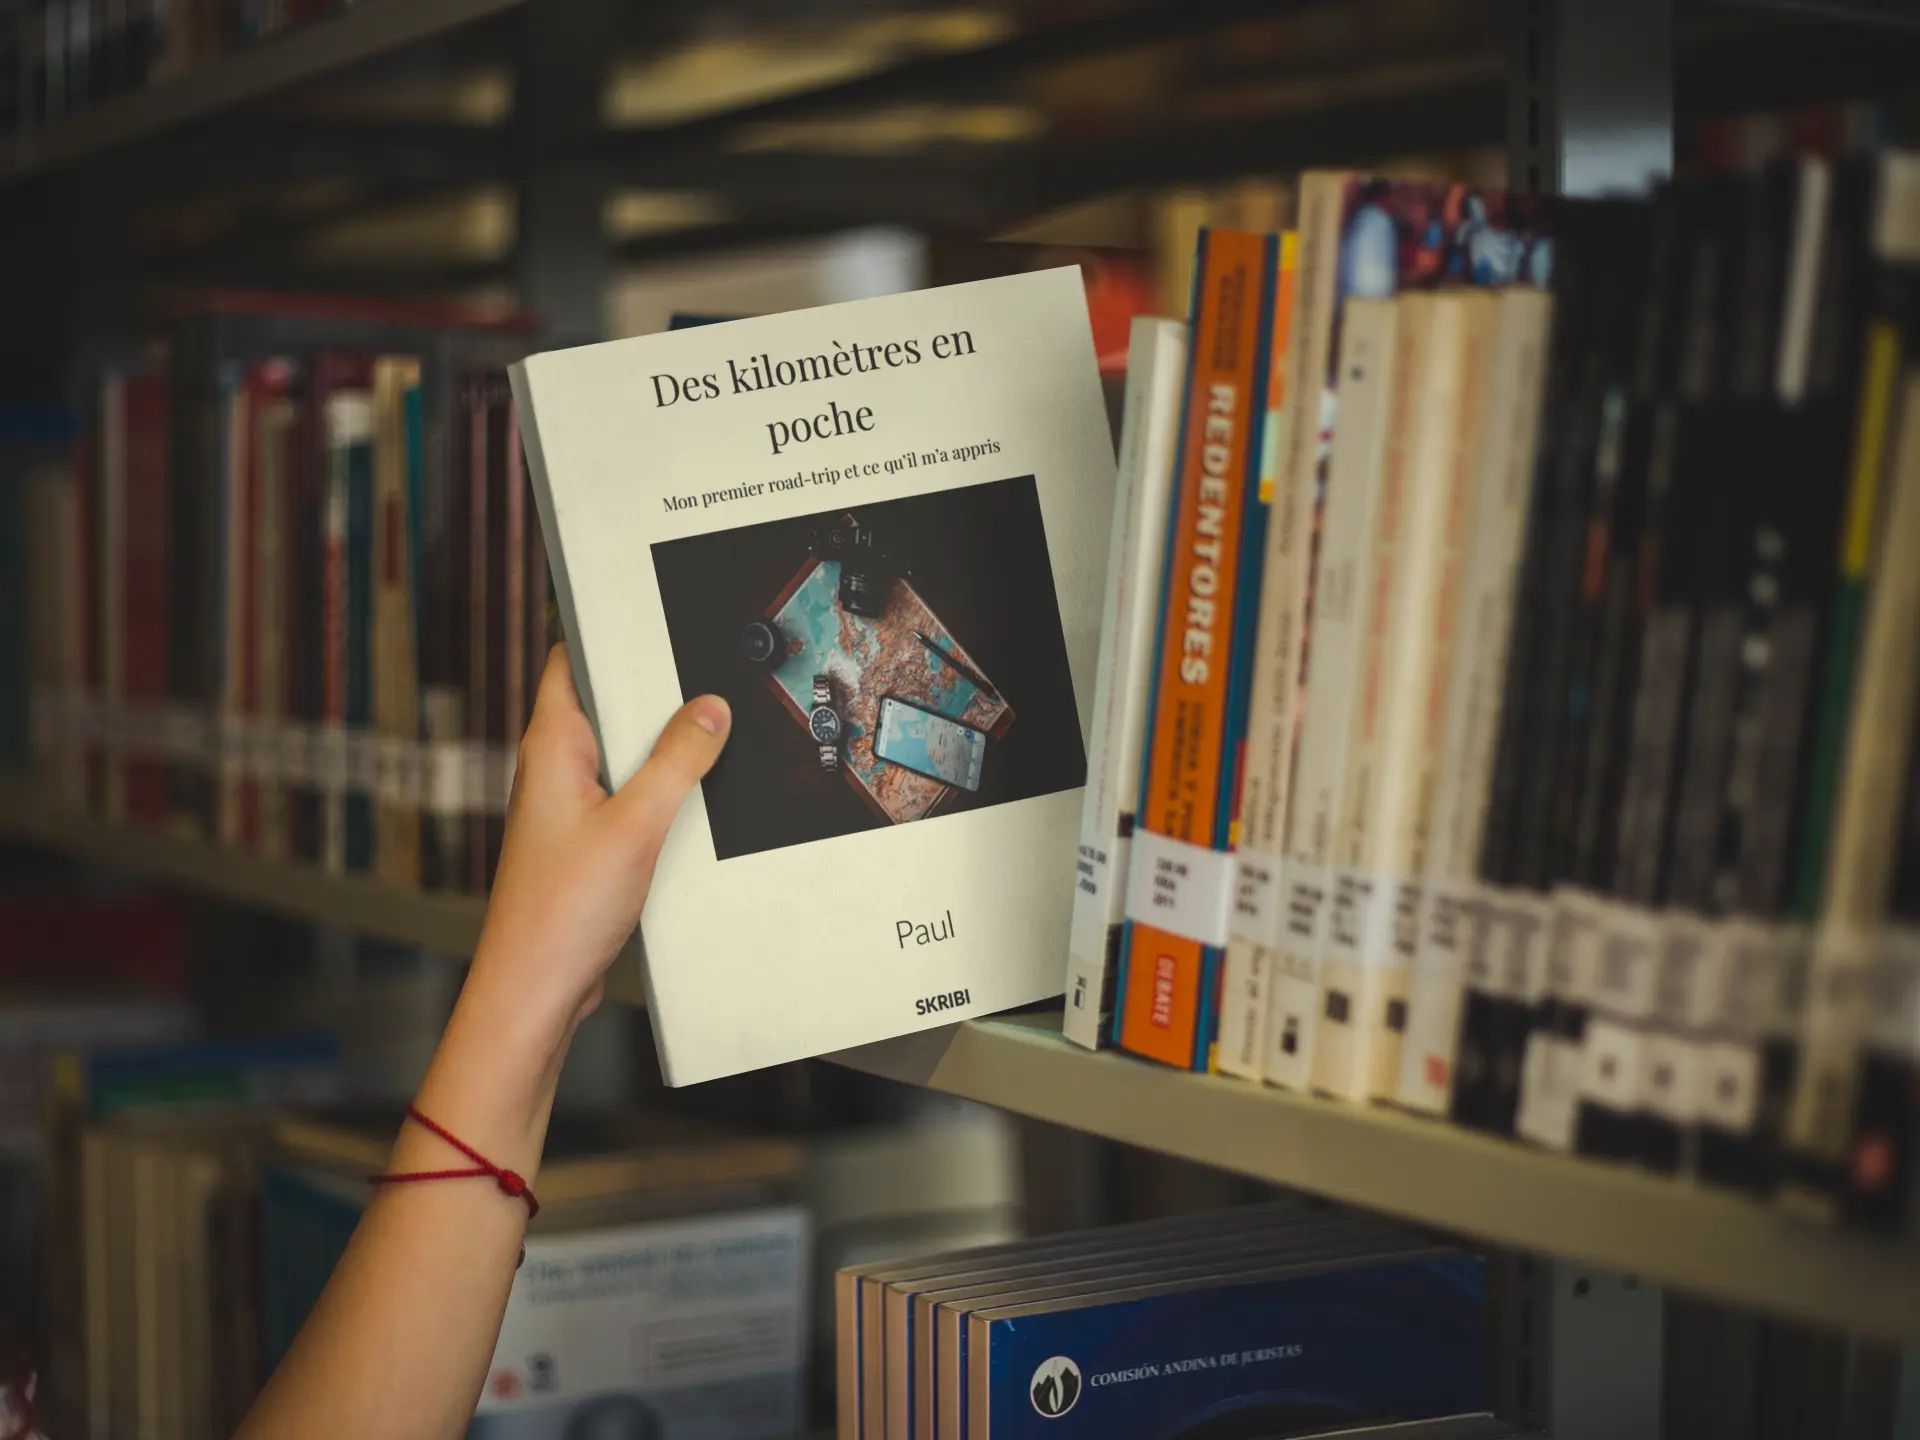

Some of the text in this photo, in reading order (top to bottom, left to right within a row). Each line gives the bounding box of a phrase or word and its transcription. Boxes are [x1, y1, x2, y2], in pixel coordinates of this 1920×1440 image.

[650, 329, 977, 408] Des kilomètres en
[765, 401, 876, 454] poche
[662, 495, 699, 513] Mon
[701, 482, 765, 508] premier
[768, 467, 841, 493] road-trip
[844, 463, 861, 479] et
[863, 462, 880, 476] ce
[952, 438, 1001, 461] appris
[1180, 383, 1237, 685] REDENTORES
[895, 909, 955, 949] Paul
[915, 988, 971, 1016] SKRIBI
[1090, 1344, 1303, 1387] COMISIÓN ANDINA DE JURISTAS
